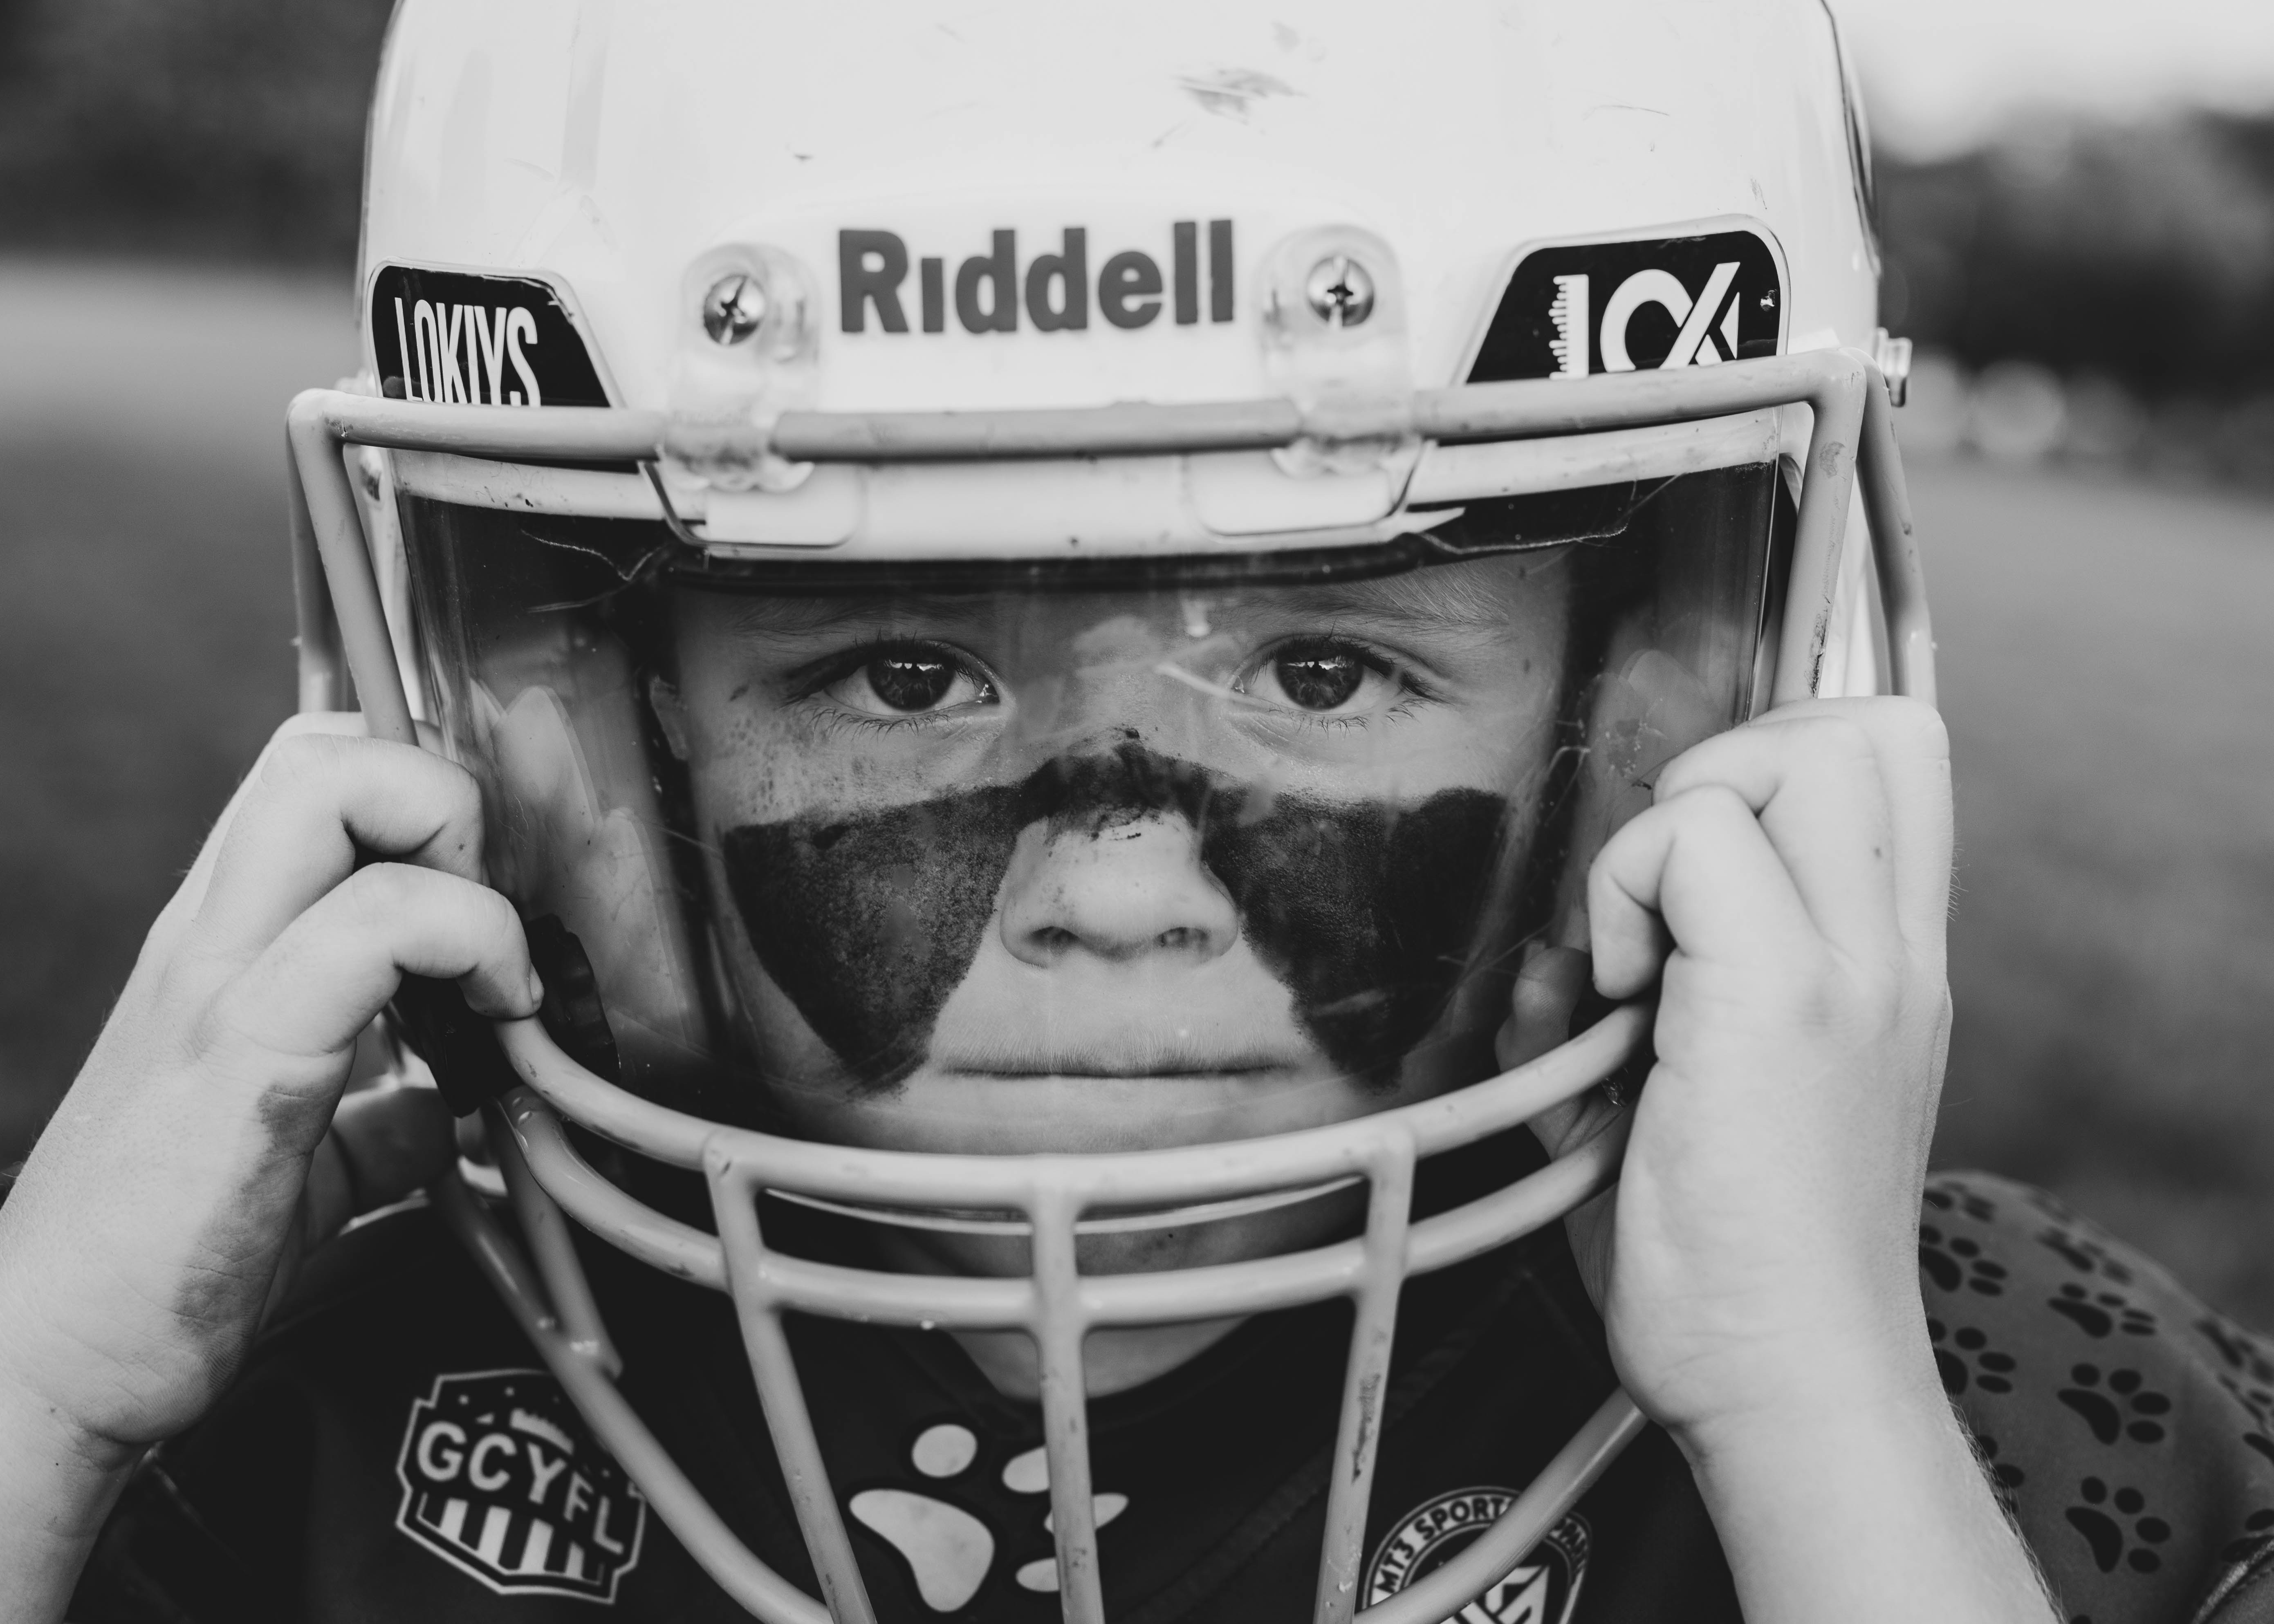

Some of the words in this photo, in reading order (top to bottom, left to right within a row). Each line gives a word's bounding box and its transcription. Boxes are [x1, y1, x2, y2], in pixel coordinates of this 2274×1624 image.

[840, 220, 1234, 333] Riddell
[395, 297, 541, 408] LOKIYS
[417, 1421, 624, 1555] GCYFL
[1375, 1538, 1414, 1593] MT3
[1414, 1497, 1515, 1541] SPORT
